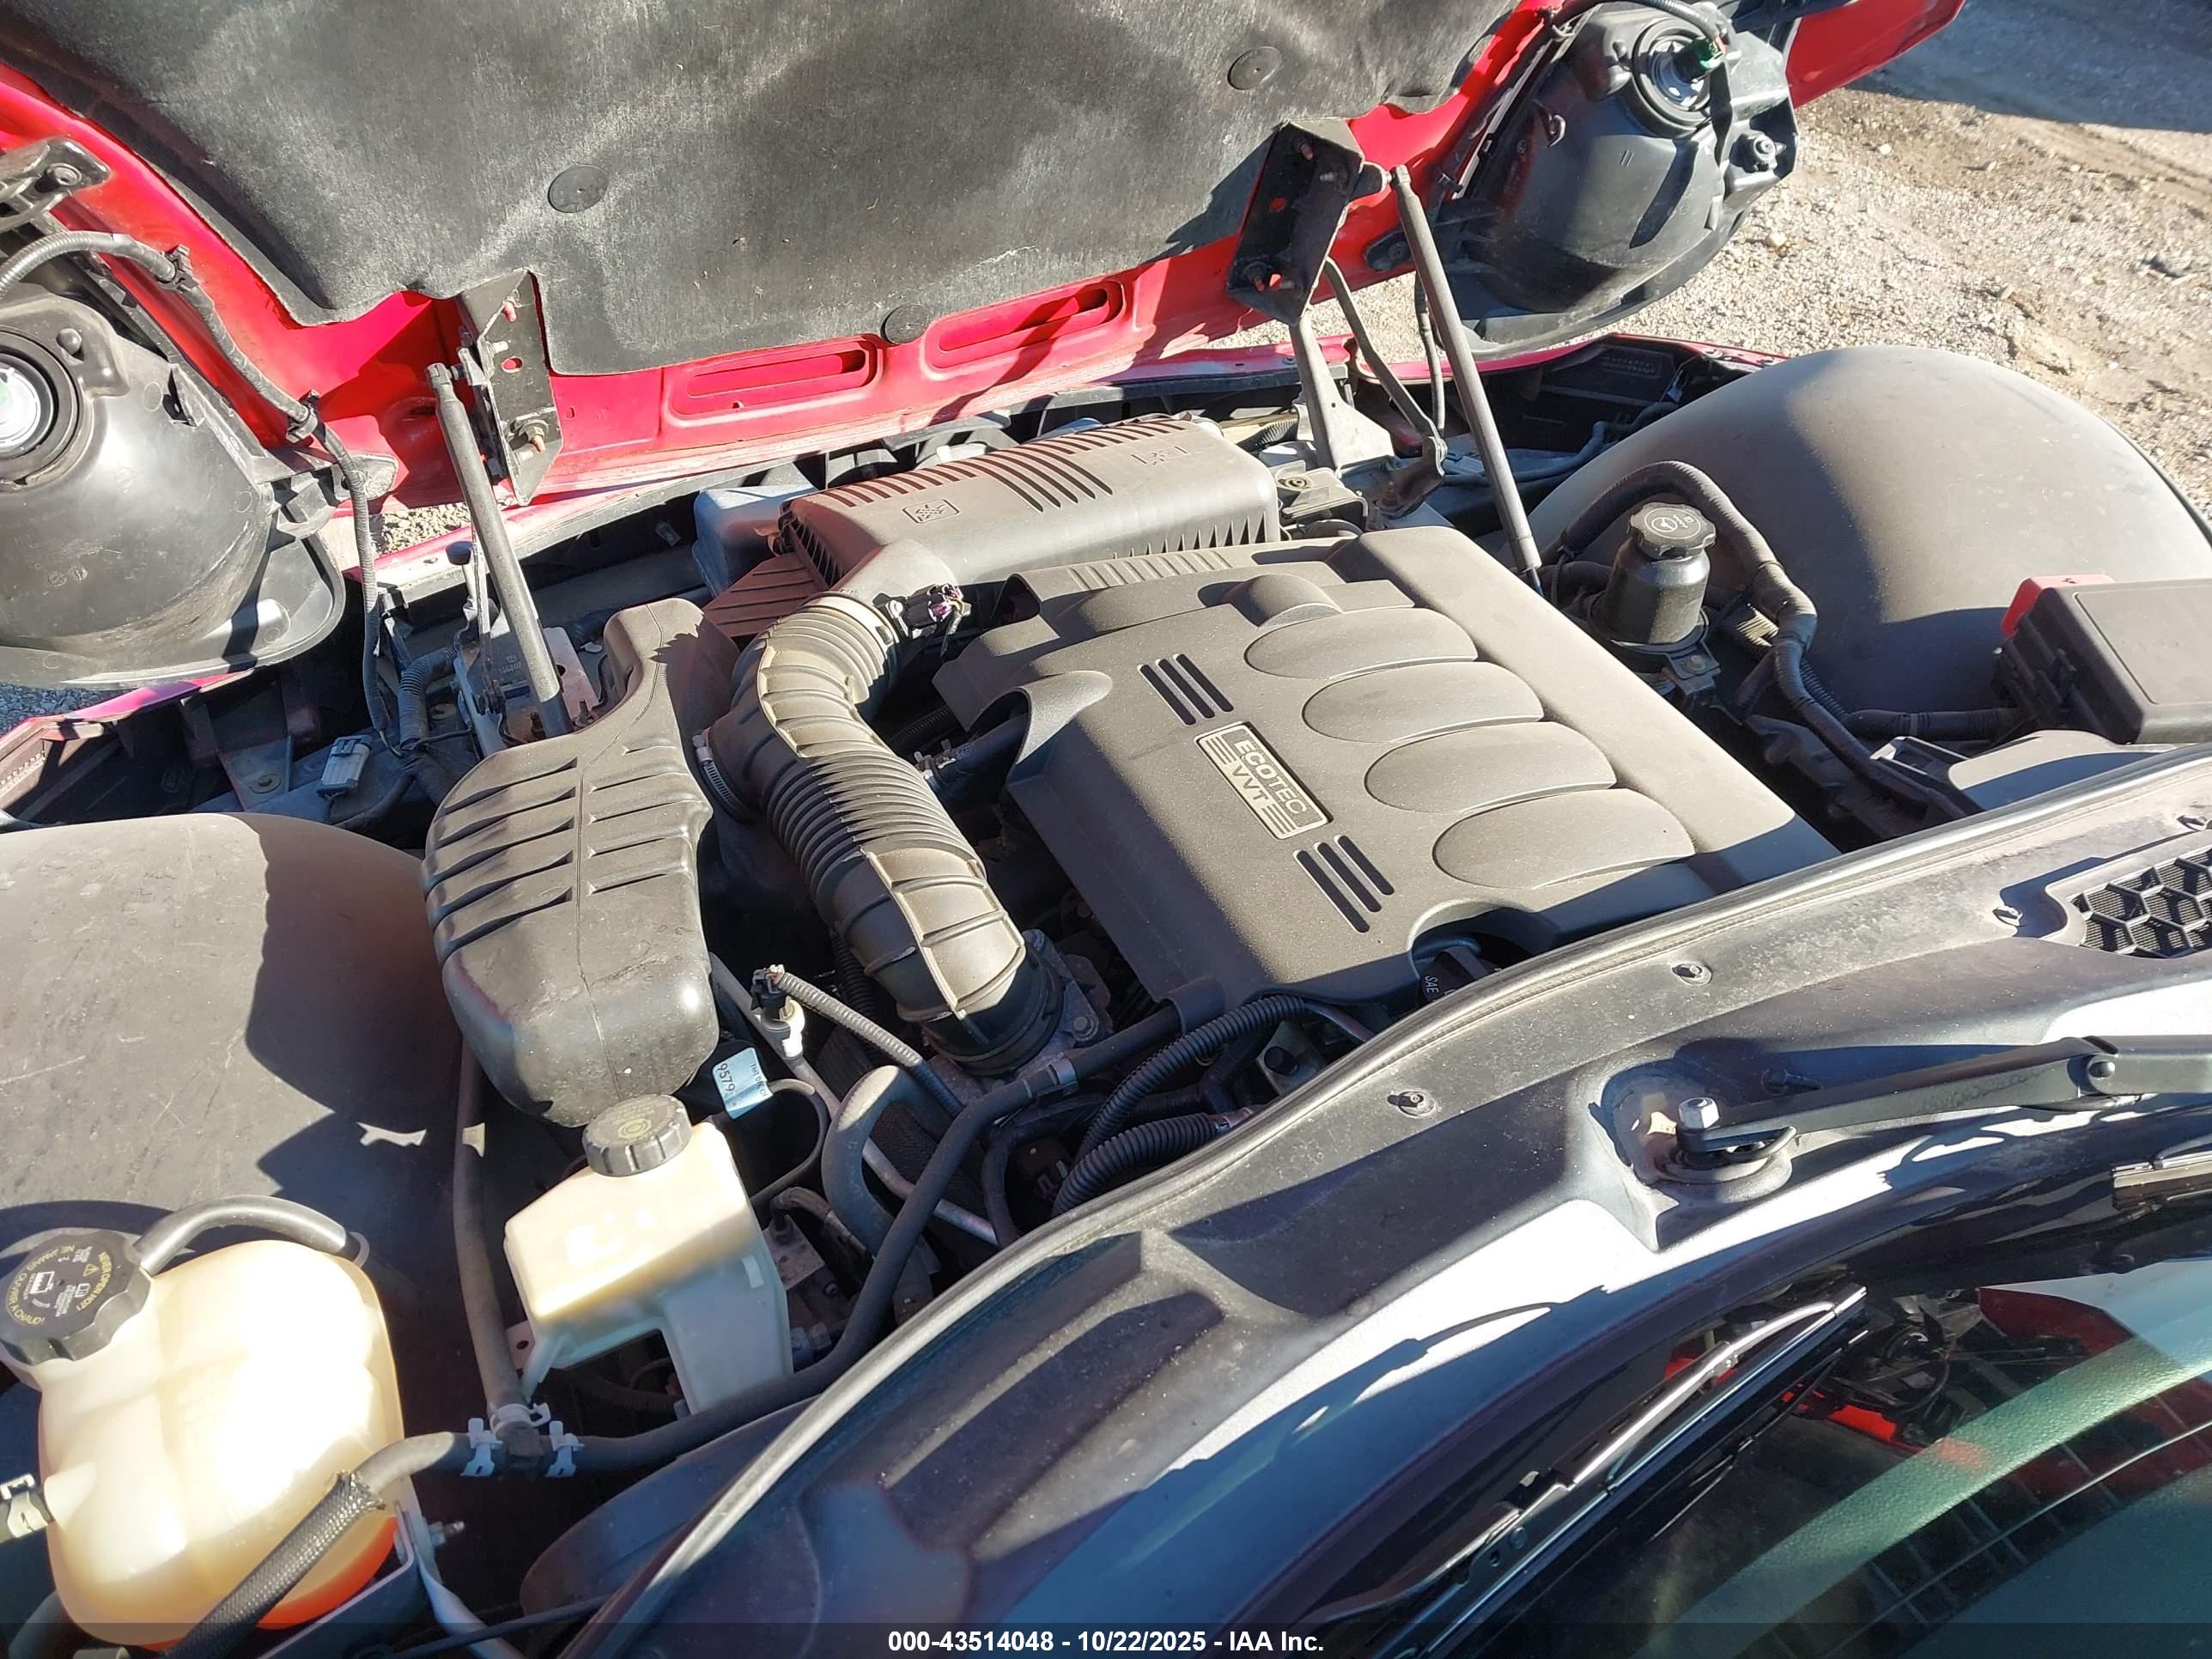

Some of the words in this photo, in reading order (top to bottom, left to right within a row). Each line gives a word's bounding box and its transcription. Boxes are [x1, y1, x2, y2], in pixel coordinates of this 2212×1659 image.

[1231, 764, 1269, 801] VVT
[1234, 739, 1307, 814] ECOTEC
[1425, 975, 1440, 994] SAE
[717, 1063, 736, 1091] 9579
